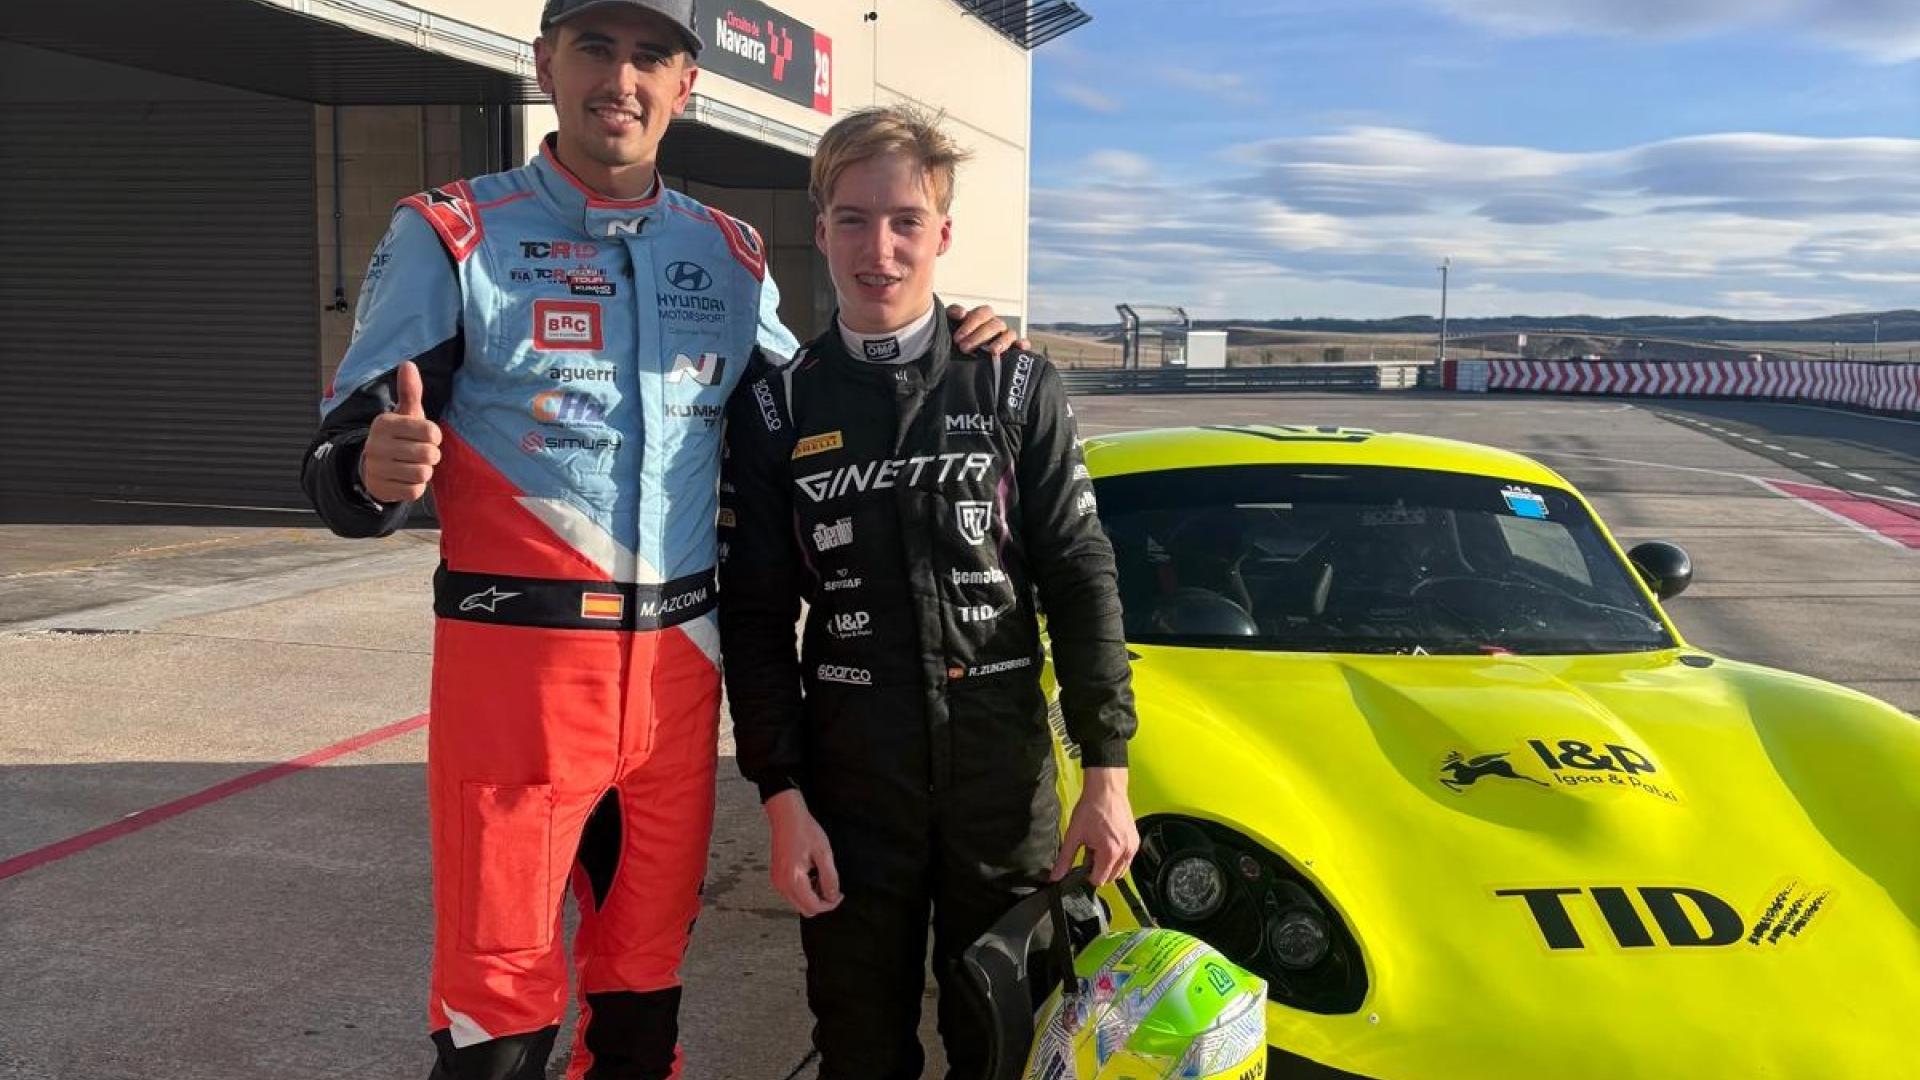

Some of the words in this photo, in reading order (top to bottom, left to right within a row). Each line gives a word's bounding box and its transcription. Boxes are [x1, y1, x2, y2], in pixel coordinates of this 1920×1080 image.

[716, 17, 766, 65] Navarra
[814, 49, 830, 97] 29
[657, 293, 726, 312] HYUNDAI
[548, 315, 587, 333] BRC
[658, 308, 726, 323] MOTORSPORT
[549, 365, 618, 383] aguerri
[1008, 353, 1034, 411] sparco
[945, 413, 994, 431] MKH
[795, 453, 995, 502] GINETTA
[834, 611, 871, 632] I&P
[957, 604, 994, 623] TID
[817, 664, 873, 685] sparco
[1527, 739, 1657, 775] I&P
[1553, 772, 1604, 786] Igoa
[1608, 773, 1625, 785] &
[1495, 886, 1746, 949] TID
